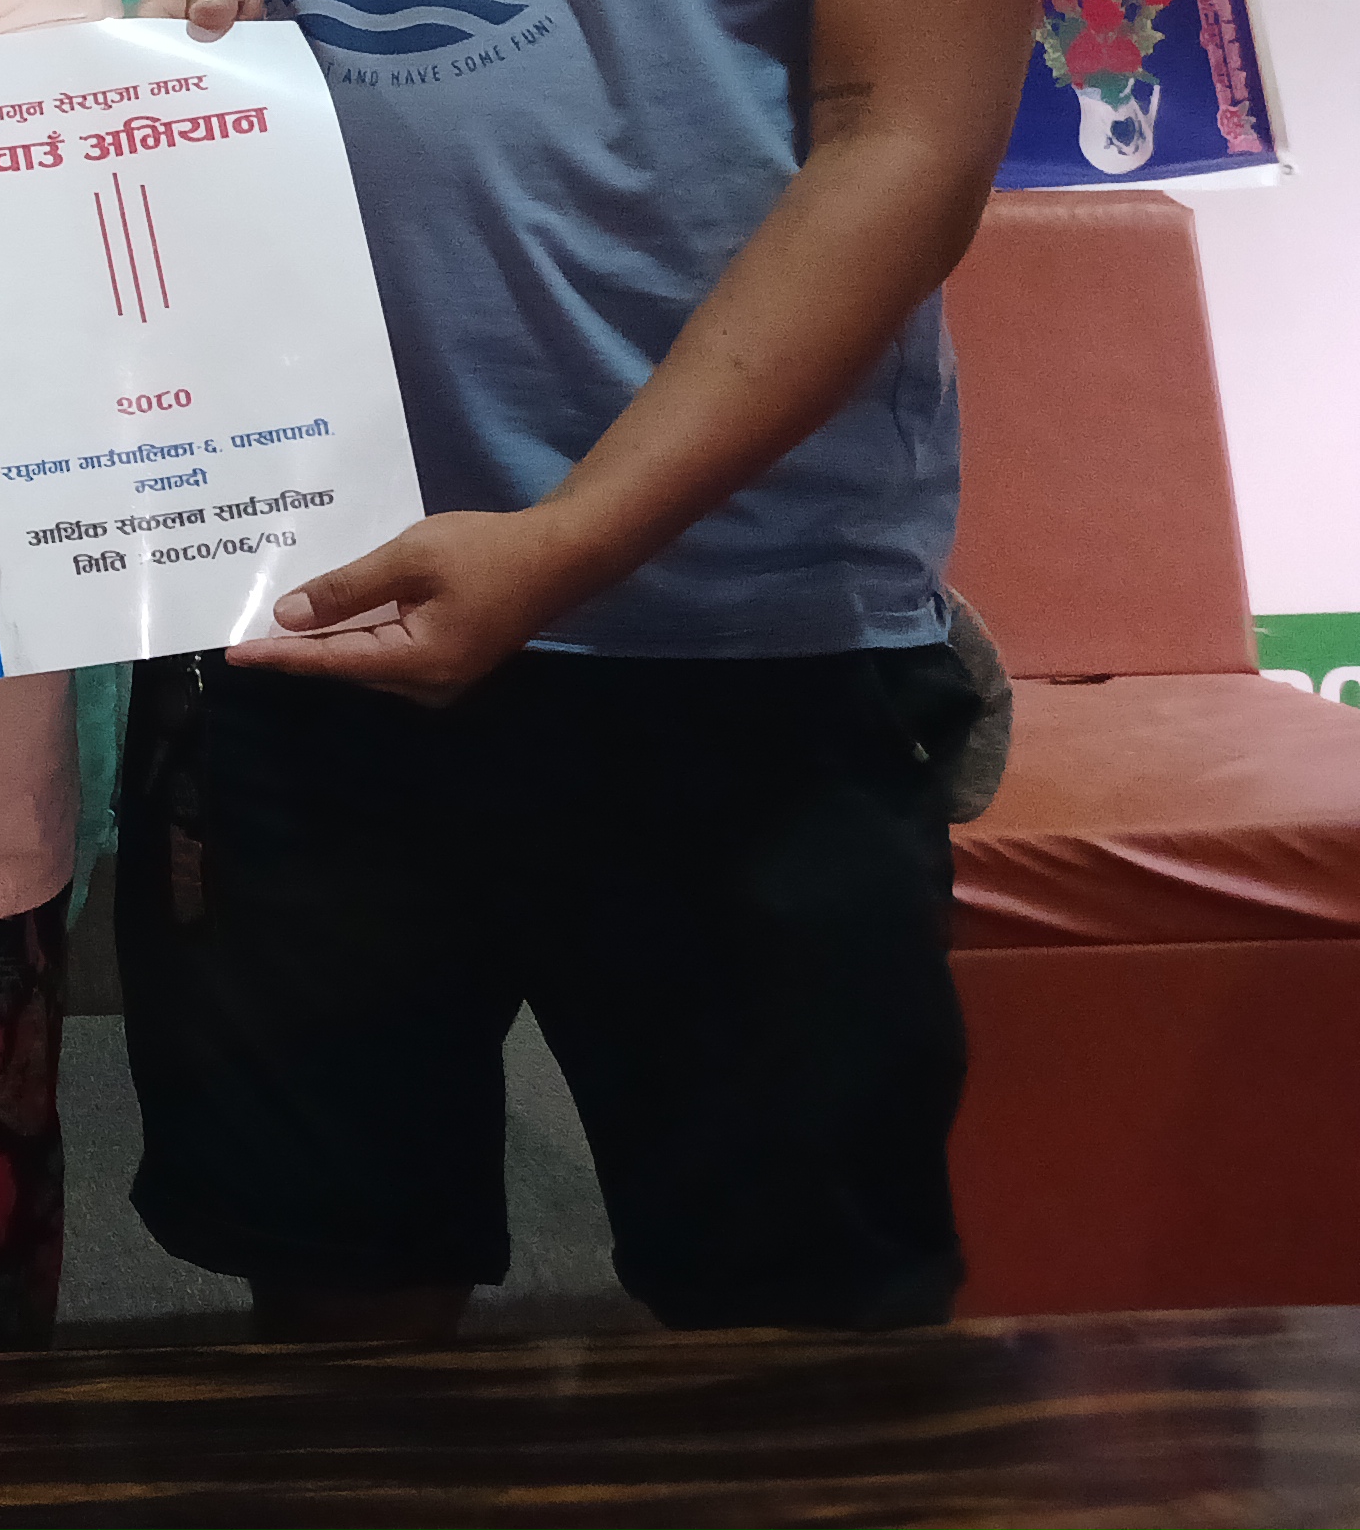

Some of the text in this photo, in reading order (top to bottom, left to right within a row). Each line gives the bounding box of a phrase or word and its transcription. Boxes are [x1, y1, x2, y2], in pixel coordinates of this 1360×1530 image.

[341, 67, 379, 87] AND
[390, 65, 441, 88] HAVE
[451, 44, 506, 77] SOME
[52, 83, 141, 114] सेरपुजा
[147, 73, 210, 97] मगर
[78, 104, 269, 162] अभियान
[115, 387, 194, 416] २०८०
[0, 457, 71, 482] रघुगंगा
[133, 467, 209, 494] म्याग्दी
[26, 488, 335, 548] आर्थिक संकलन सार्वजनिक
[72, 549, 128, 577] मिति
